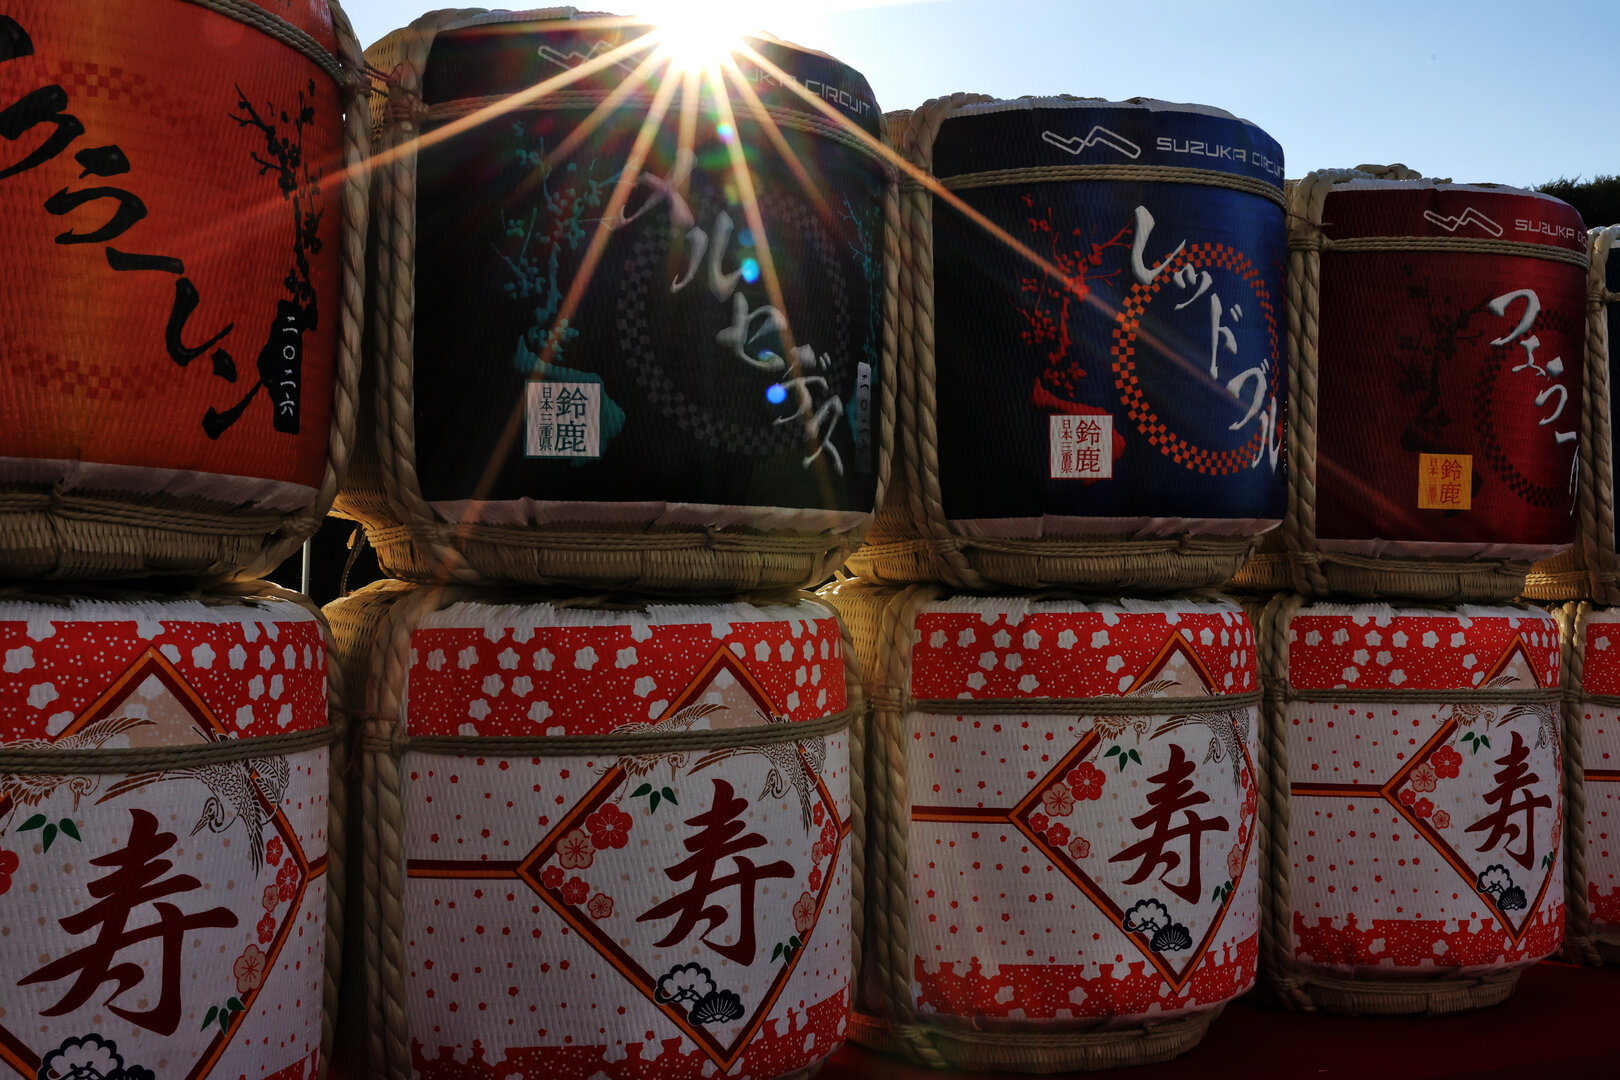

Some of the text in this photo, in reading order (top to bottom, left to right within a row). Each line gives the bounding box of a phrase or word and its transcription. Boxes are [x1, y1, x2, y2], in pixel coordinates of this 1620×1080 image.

[805, 79, 871, 118] CIRCUIT
[1156, 137, 1247, 162] SUZUKA
[0, 14, 263, 440] クラーレン
[1515, 219, 1575, 240] SUZUKA
[1131, 205, 1281, 474] レッドブル
[539, 387, 553, 451] 日本三重県
[554, 387, 589, 452] 鈴鹿
[1075, 420, 1101, 472] 鈴鹿
[1440, 459, 1462, 504] 鈴鹿
[1108, 744, 1230, 905] 寿
[1464, 731, 1552, 871] 寿
[635, 778, 796, 967] 寿
[16, 808, 239, 1037] 寿
